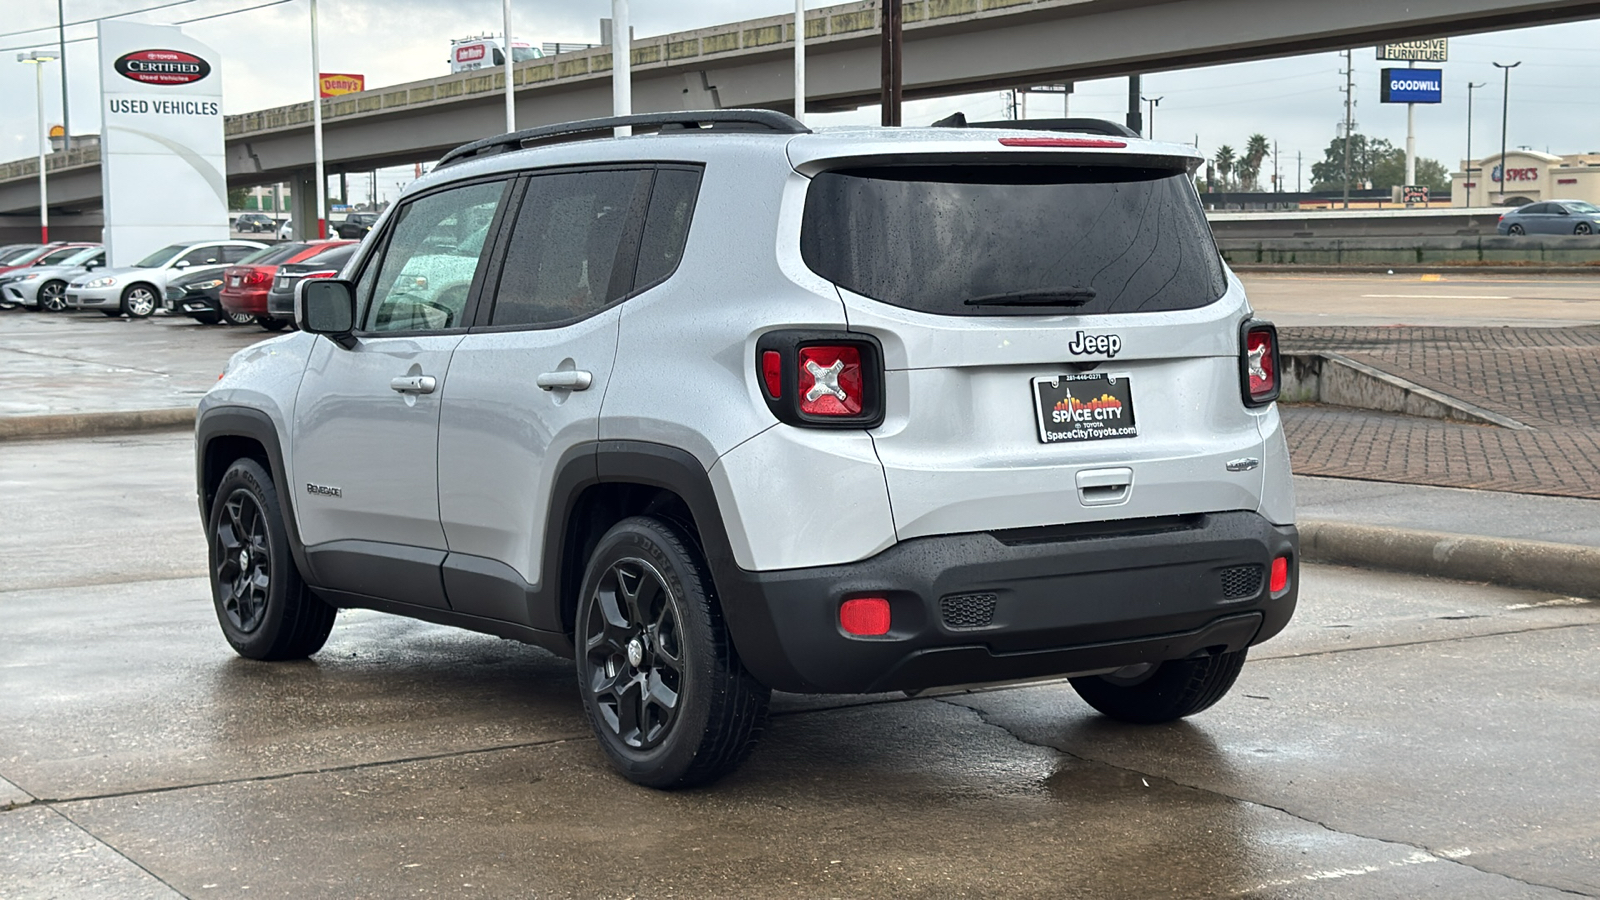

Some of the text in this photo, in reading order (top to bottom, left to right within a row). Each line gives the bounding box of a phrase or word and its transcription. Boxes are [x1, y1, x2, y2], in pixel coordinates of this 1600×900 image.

[1388, 49, 1445, 59] FURNITURE
[127, 60, 200, 73] CERTIFIED
[324, 80, 358, 91] Denny's
[1390, 80, 1440, 91] GOODWILL
[110, 99, 218, 116] USED VEHICLES
[1069, 332, 1121, 358] Jeep
[1052, 406, 1122, 423] SPACE CITY
[1083, 421, 1104, 429] TOYOTA
[1047, 427, 1137, 441] SpaceCityToyota.com
